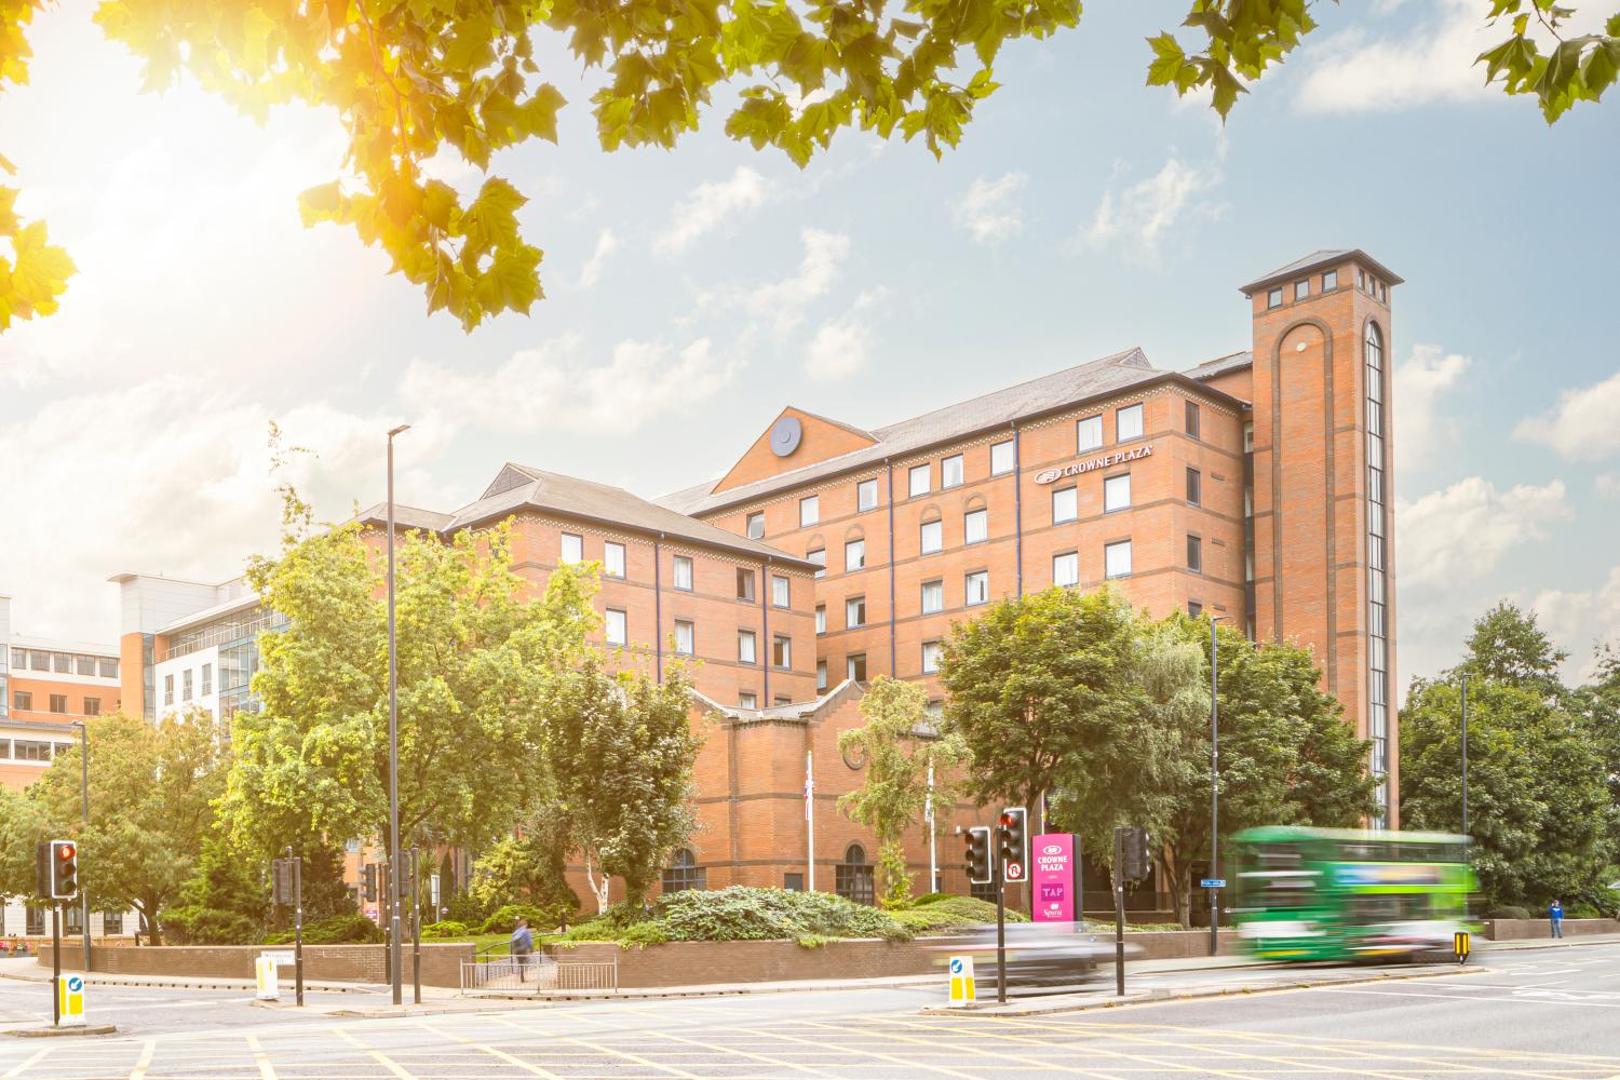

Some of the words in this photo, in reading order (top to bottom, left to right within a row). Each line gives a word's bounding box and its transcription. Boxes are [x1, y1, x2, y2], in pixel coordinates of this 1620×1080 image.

[1064, 456, 1111, 476] CROWNE
[1114, 447, 1151, 463] PLAZA
[1037, 856, 1067, 864] CROWNE
[1042, 887, 1063, 897] TAP
